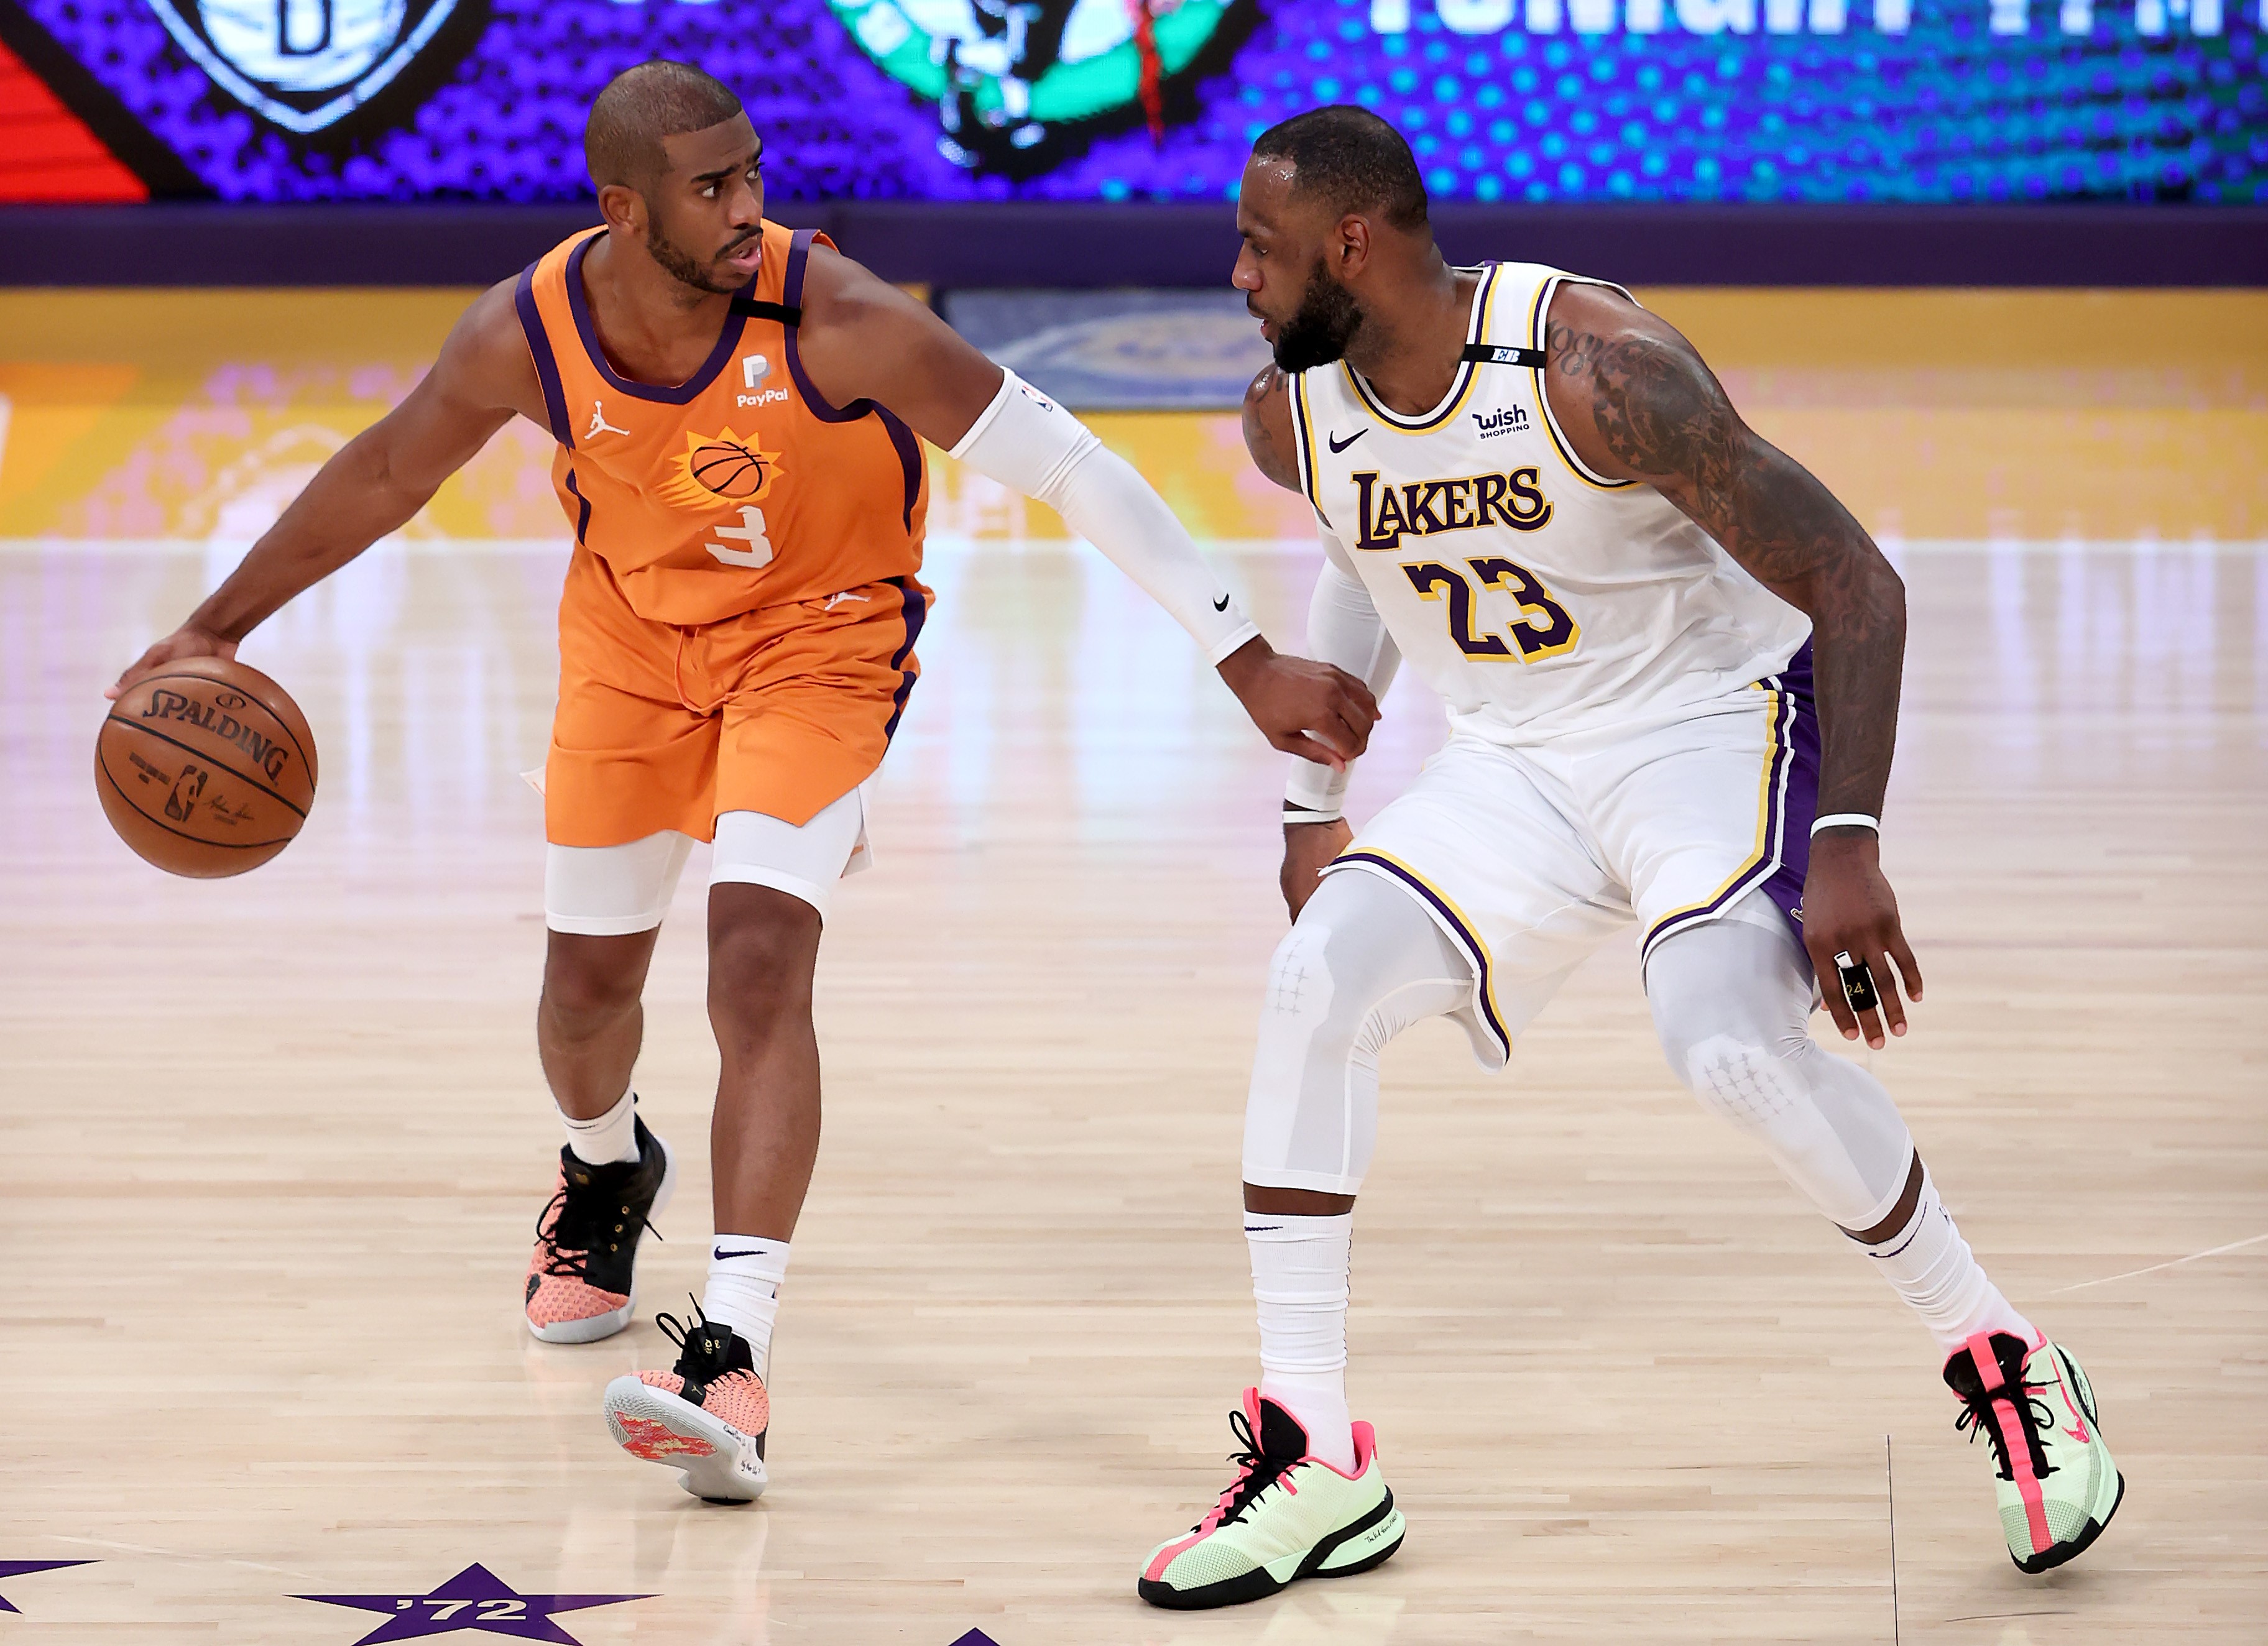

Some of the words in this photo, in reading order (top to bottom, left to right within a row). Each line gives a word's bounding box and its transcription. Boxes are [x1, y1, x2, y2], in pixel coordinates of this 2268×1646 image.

[1491, 347, 1521, 363] EB
[737, 388, 788, 407] PayPal
[1472, 404, 1527, 430] wish
[1480, 424, 1529, 439] SHOPPING
[1350, 466, 1554, 551] LAKERS
[704, 505, 773, 569] 3
[1399, 556, 1581, 664] 23
[142, 689, 289, 781] SPALDING
[1845, 982, 1865, 996] 24
